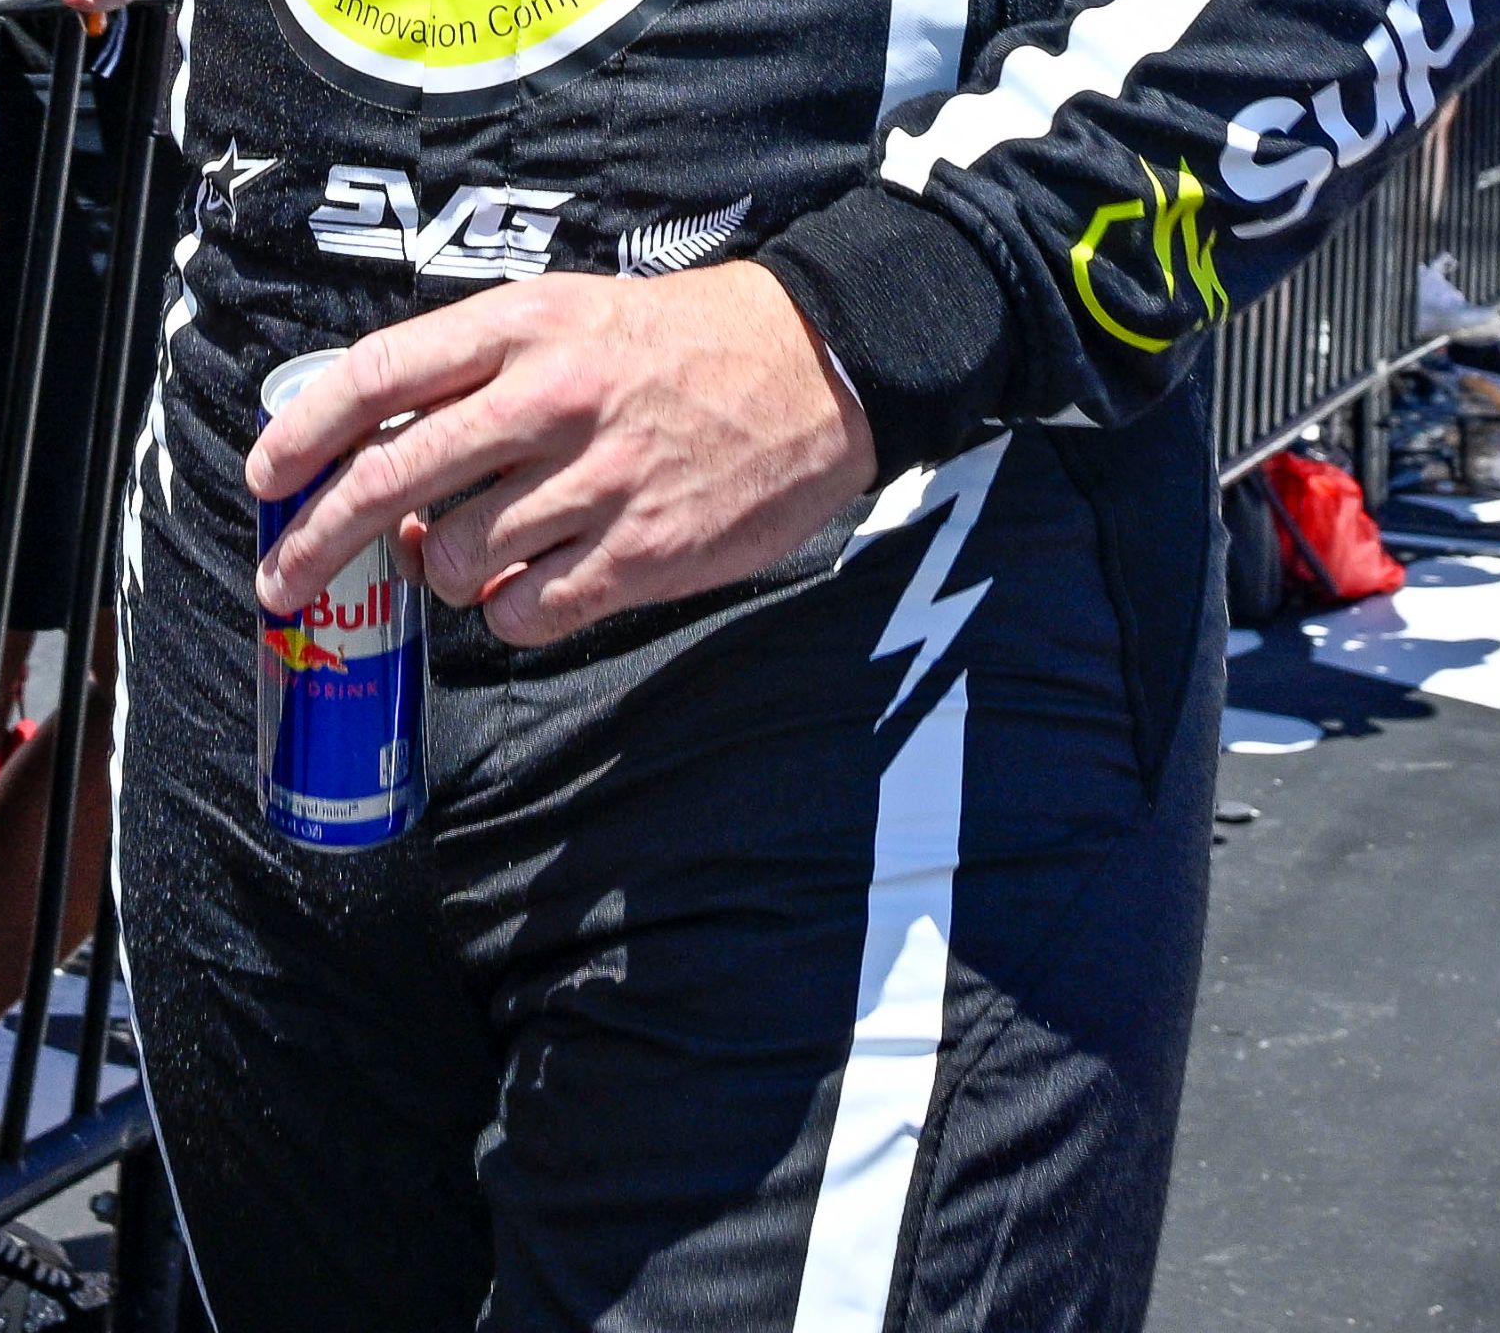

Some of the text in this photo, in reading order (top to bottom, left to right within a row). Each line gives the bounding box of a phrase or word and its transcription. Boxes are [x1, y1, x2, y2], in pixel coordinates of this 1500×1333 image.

[308, 163, 576, 282] SVG
[302, 580, 391, 631] Bull
[308, 678, 379, 701] DRINK
